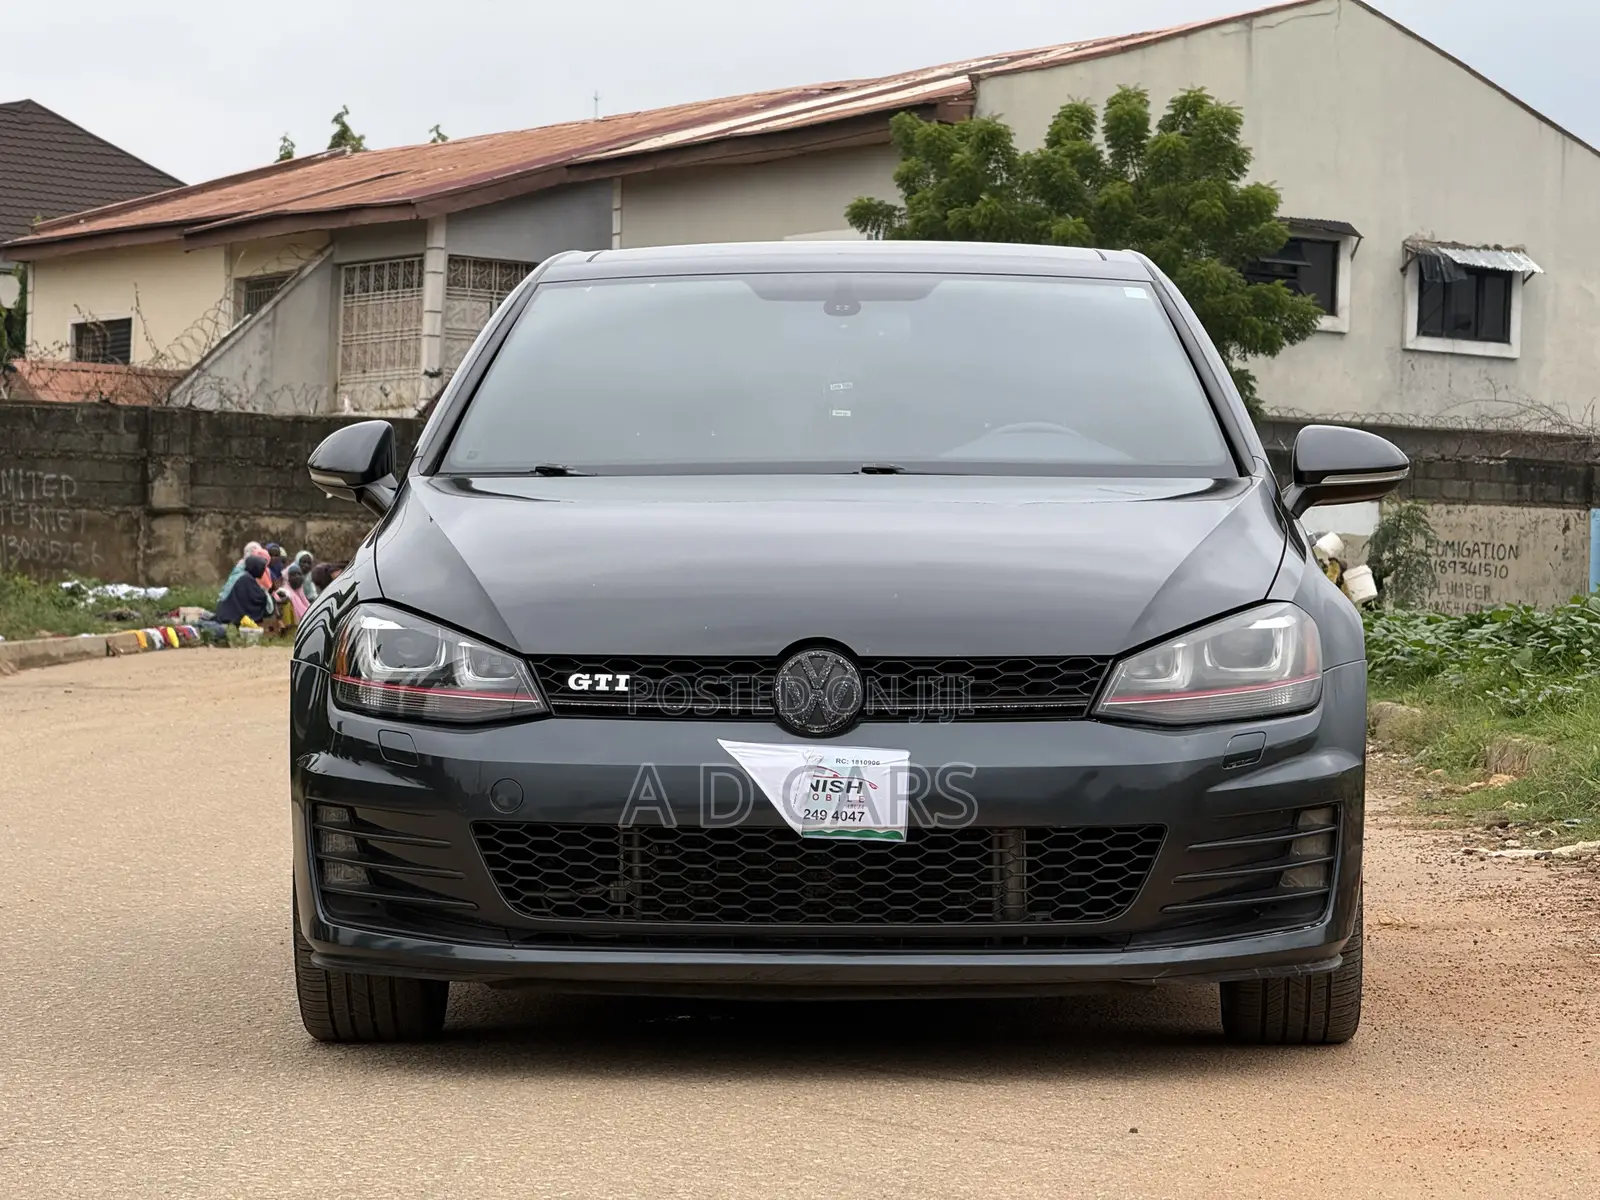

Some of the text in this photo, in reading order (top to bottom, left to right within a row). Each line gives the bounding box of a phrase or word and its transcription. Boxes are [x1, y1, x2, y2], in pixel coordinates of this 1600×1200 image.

[1425, 540, 1518, 561] FUMIGATION
[567, 674, 630, 692] GTI
[803, 808, 865, 823] 249 4047
